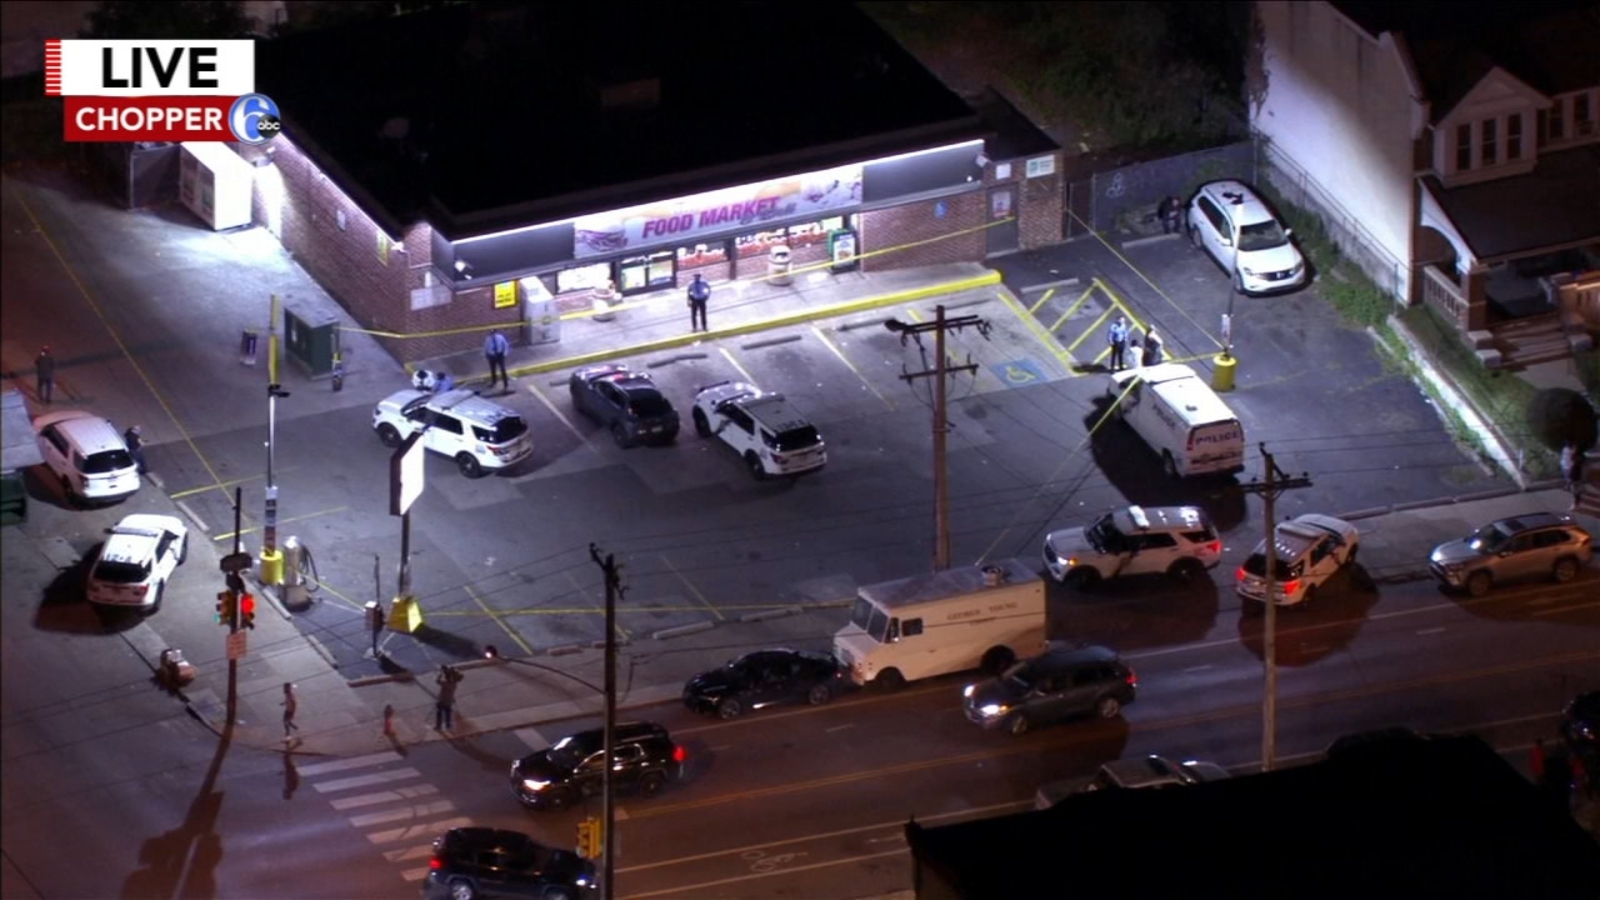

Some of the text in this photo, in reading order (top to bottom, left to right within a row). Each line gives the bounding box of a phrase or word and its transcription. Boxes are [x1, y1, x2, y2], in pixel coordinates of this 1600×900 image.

[642, 214, 693, 238] FOOD
[698, 197, 780, 228] MARKET
[1196, 431, 1239, 444] POLICE
